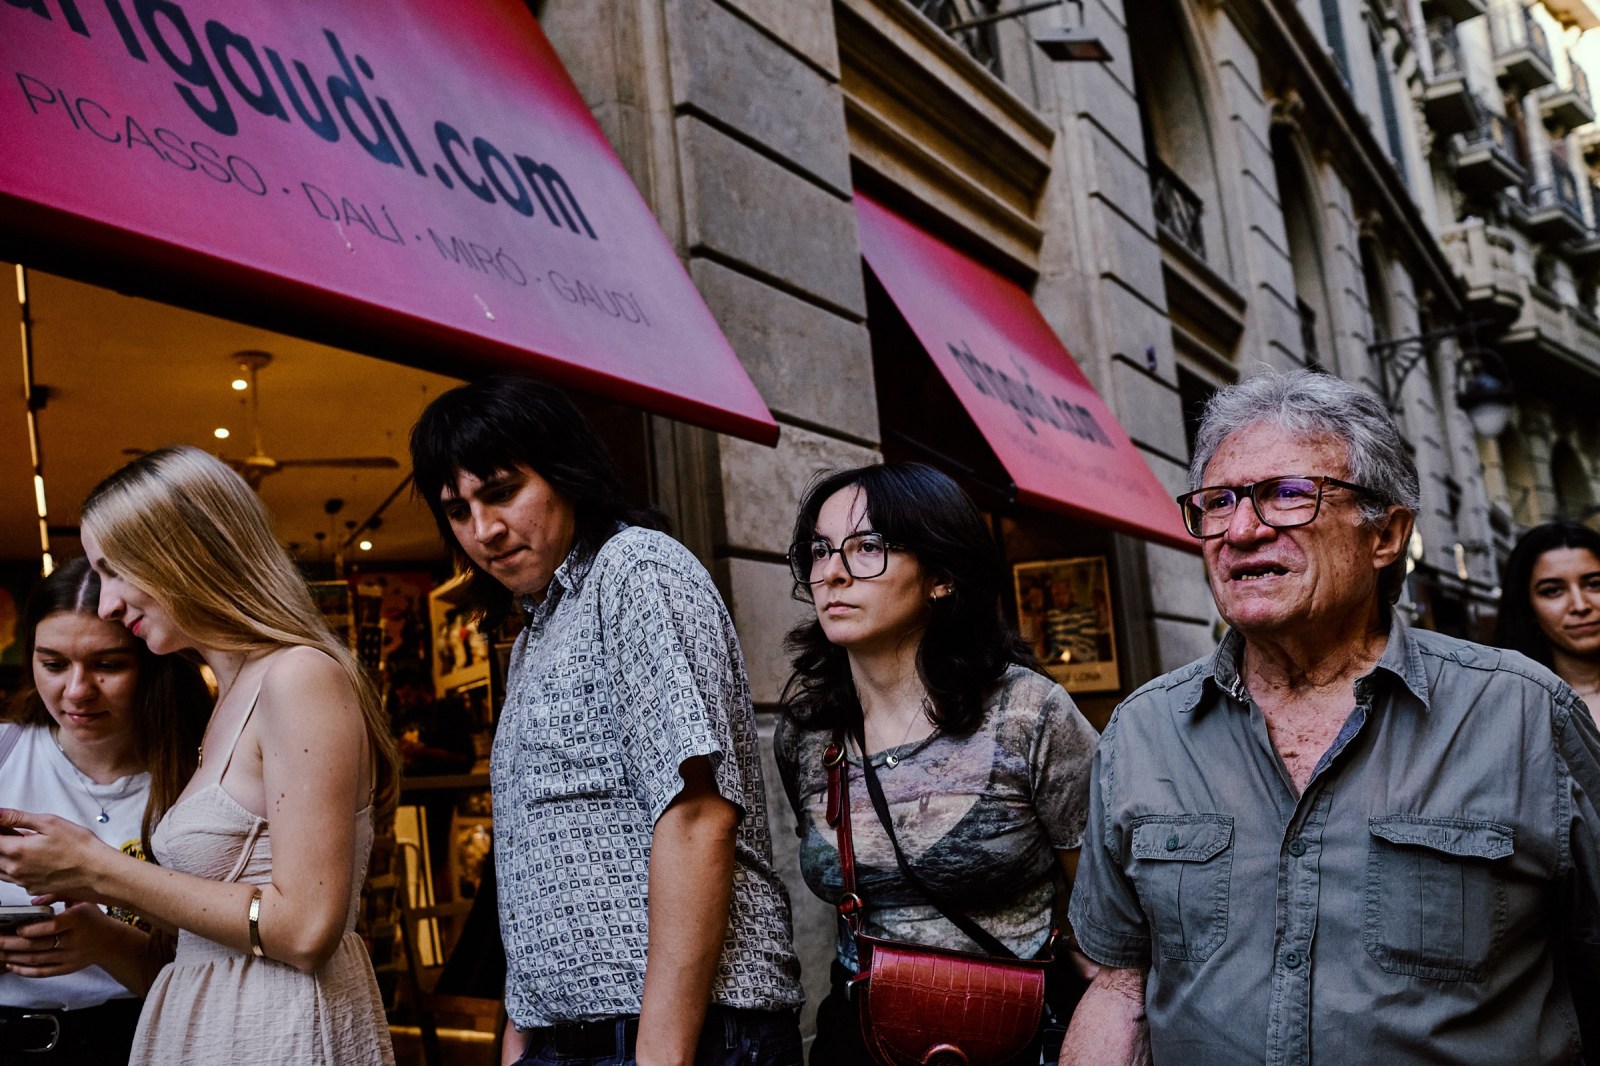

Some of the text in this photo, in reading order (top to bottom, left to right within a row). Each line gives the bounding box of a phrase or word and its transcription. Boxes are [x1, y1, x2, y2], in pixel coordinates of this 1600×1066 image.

[16, 72, 651, 327] PICASSO DALÍ MIRÓ GAUDÍ
